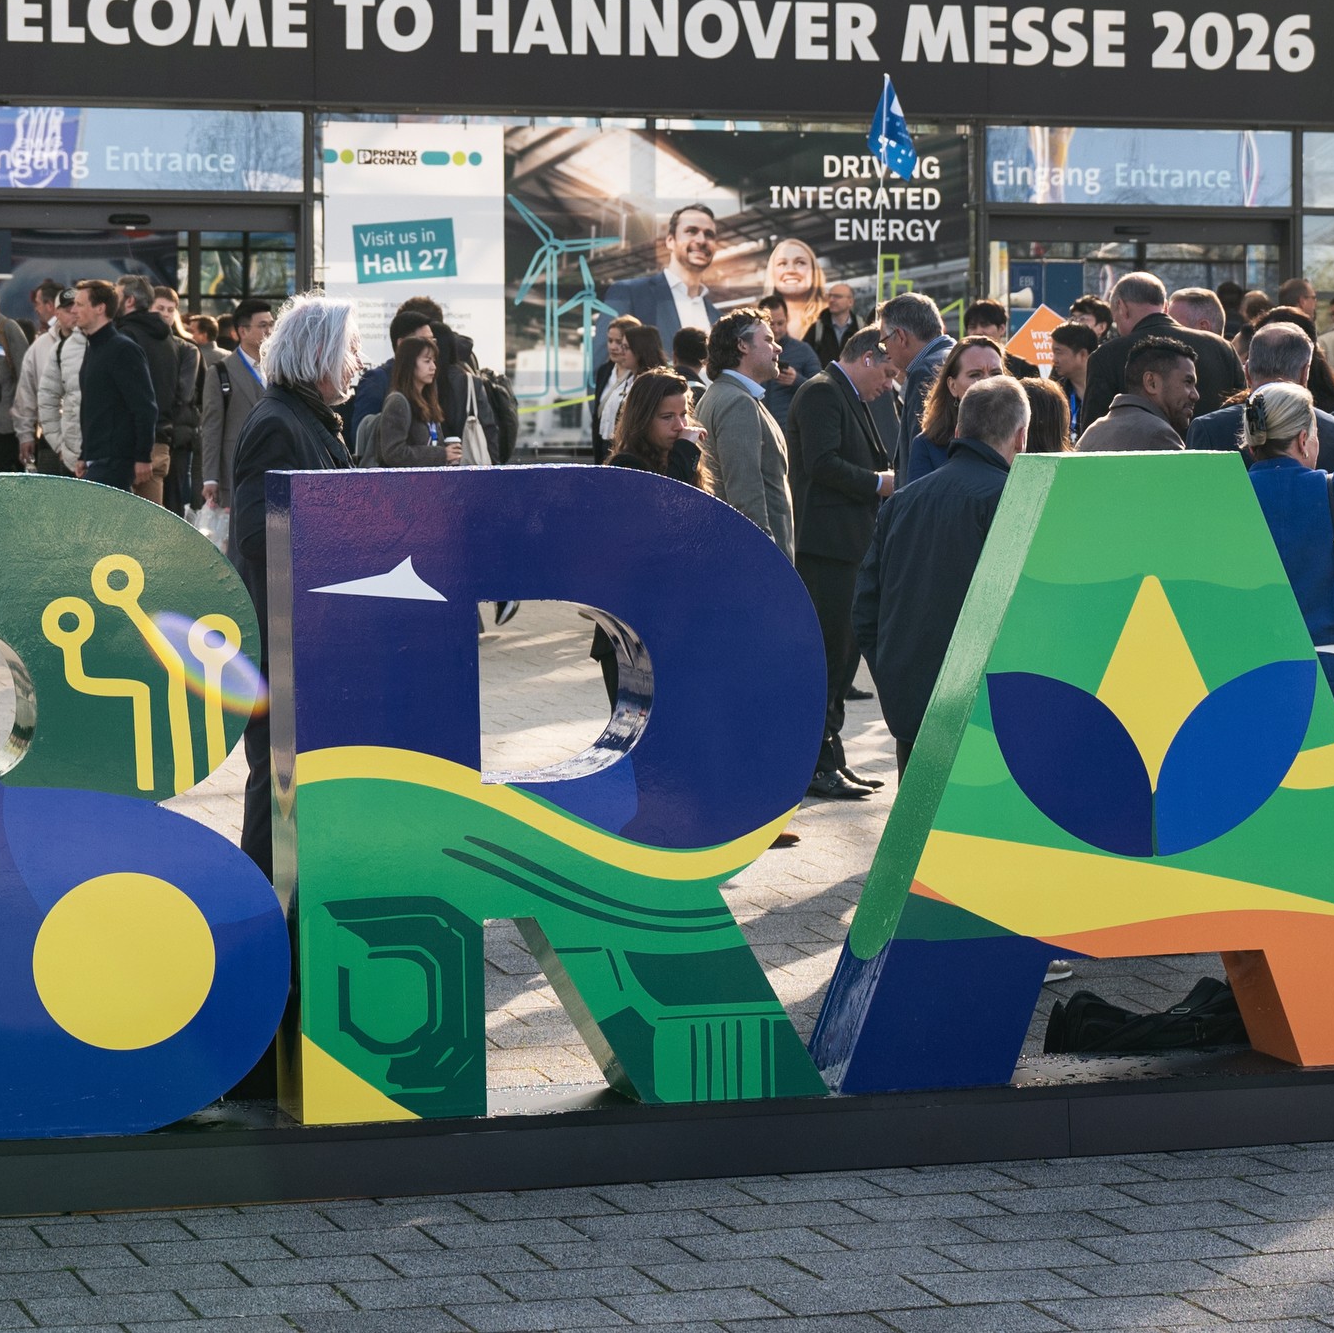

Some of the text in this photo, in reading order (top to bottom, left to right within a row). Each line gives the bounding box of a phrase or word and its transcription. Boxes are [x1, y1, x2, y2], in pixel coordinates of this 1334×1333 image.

[900, 4, 1126, 67] MESSE
[1151, 10, 1316, 73] 2026
[104, 144, 237, 173] Entrance
[823, 155, 941, 179] DRIVG
[992, 160, 1232, 195] Eingang Entrance
[769, 185, 941, 210] INTEGRATED
[360, 228, 436, 247] Visit us in
[834, 218, 942, 242] ENERGY
[362, 248, 449, 275] Hall 27
